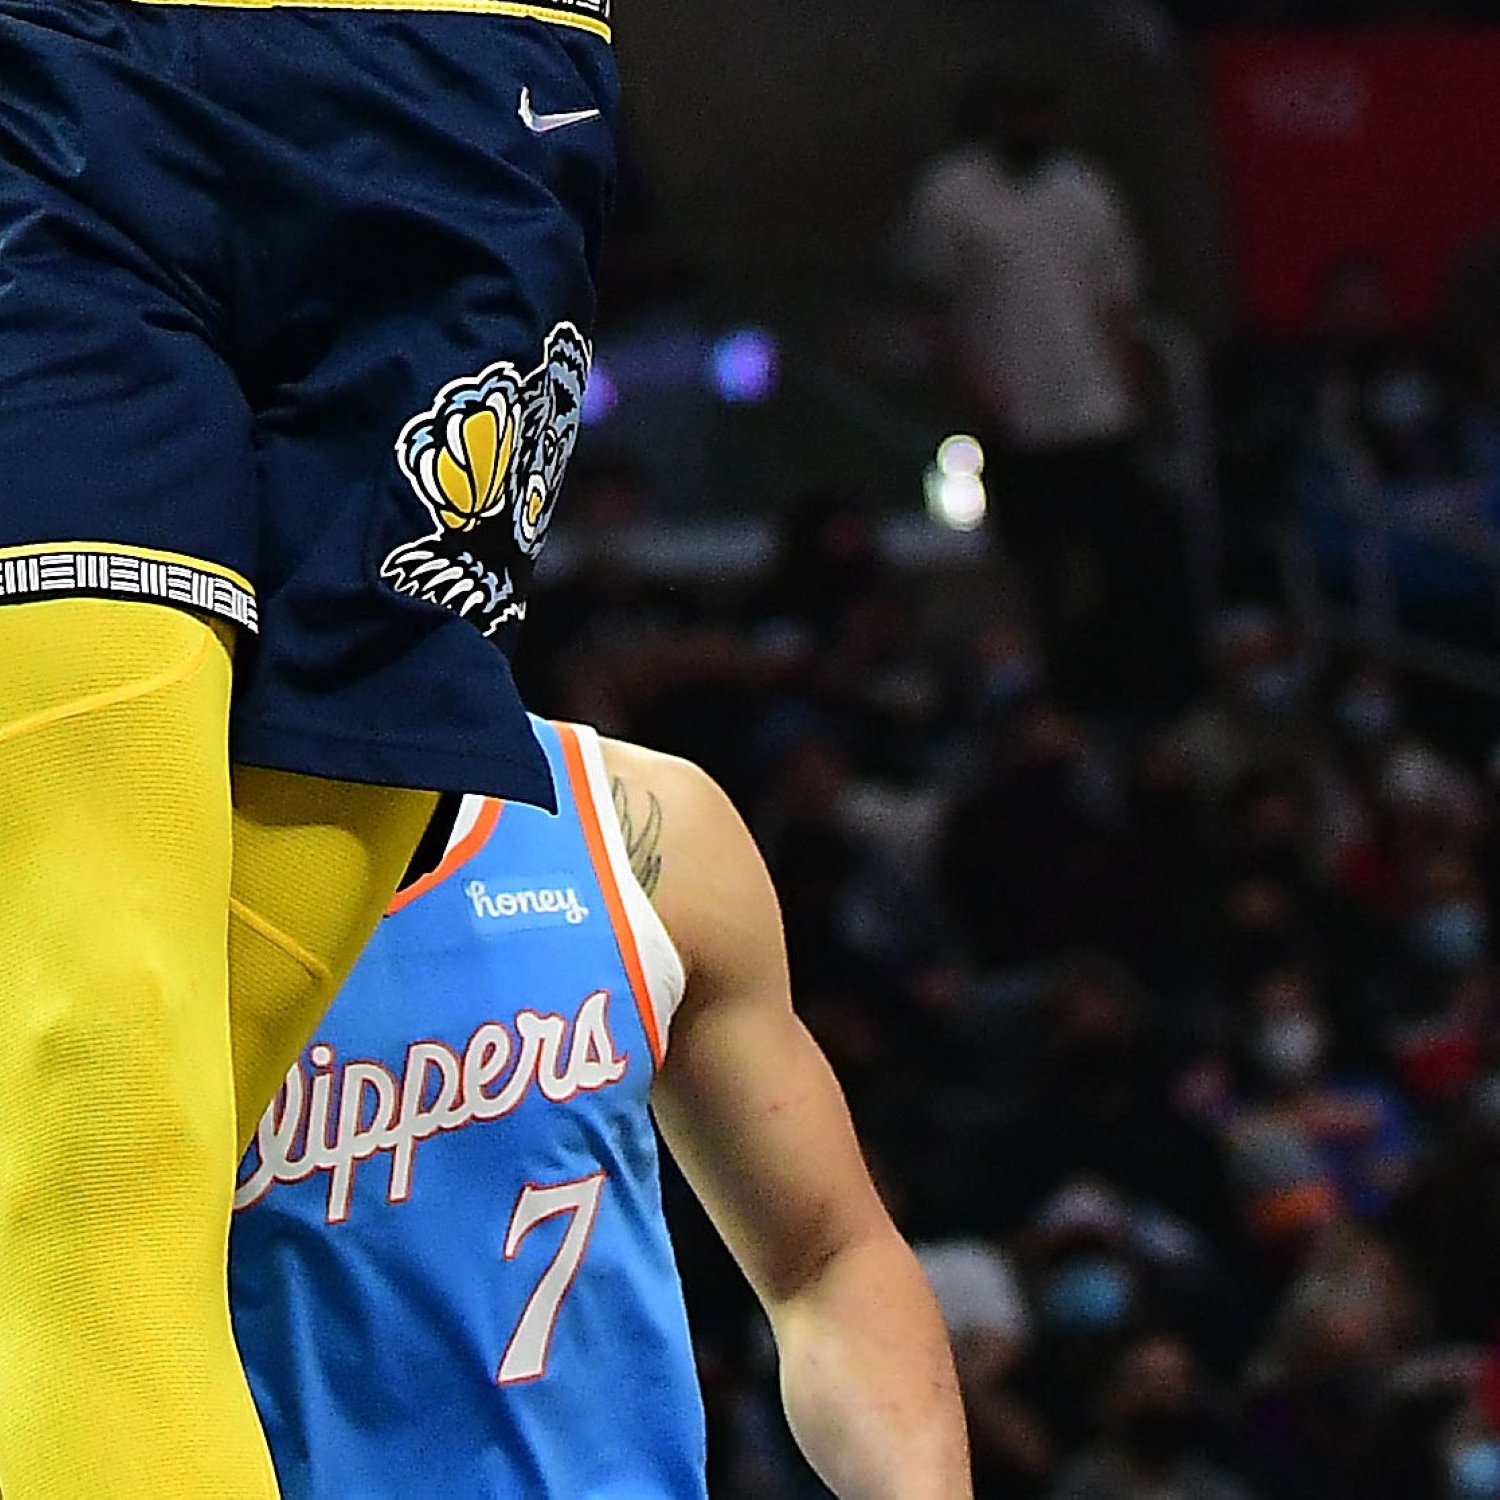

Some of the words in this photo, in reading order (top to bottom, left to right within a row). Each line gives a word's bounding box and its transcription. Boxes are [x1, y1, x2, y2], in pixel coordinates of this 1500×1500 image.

[466, 881, 588, 922] honey
[233, 990, 628, 1223] lippers
[496, 1171, 605, 1385] 7
